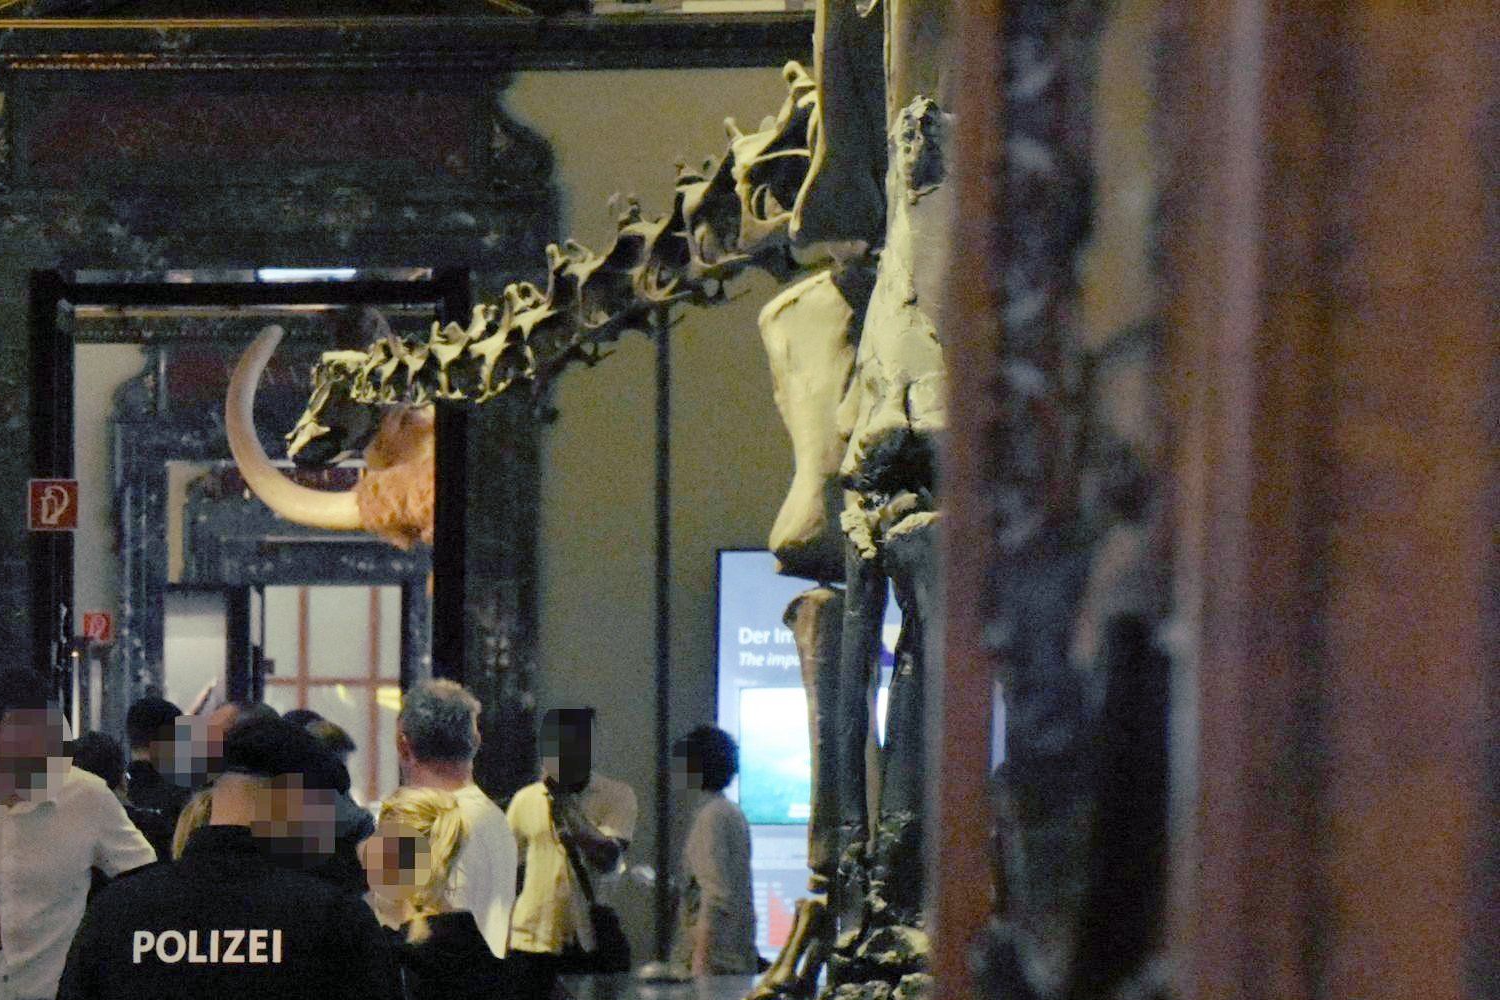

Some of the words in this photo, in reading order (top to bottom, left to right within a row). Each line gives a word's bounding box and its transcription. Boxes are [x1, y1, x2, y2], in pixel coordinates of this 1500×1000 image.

[738, 627, 771, 644] Der
[739, 651, 764, 667] The
[766, 651, 801, 669] impa
[133, 929, 283, 964] POLIZEI
